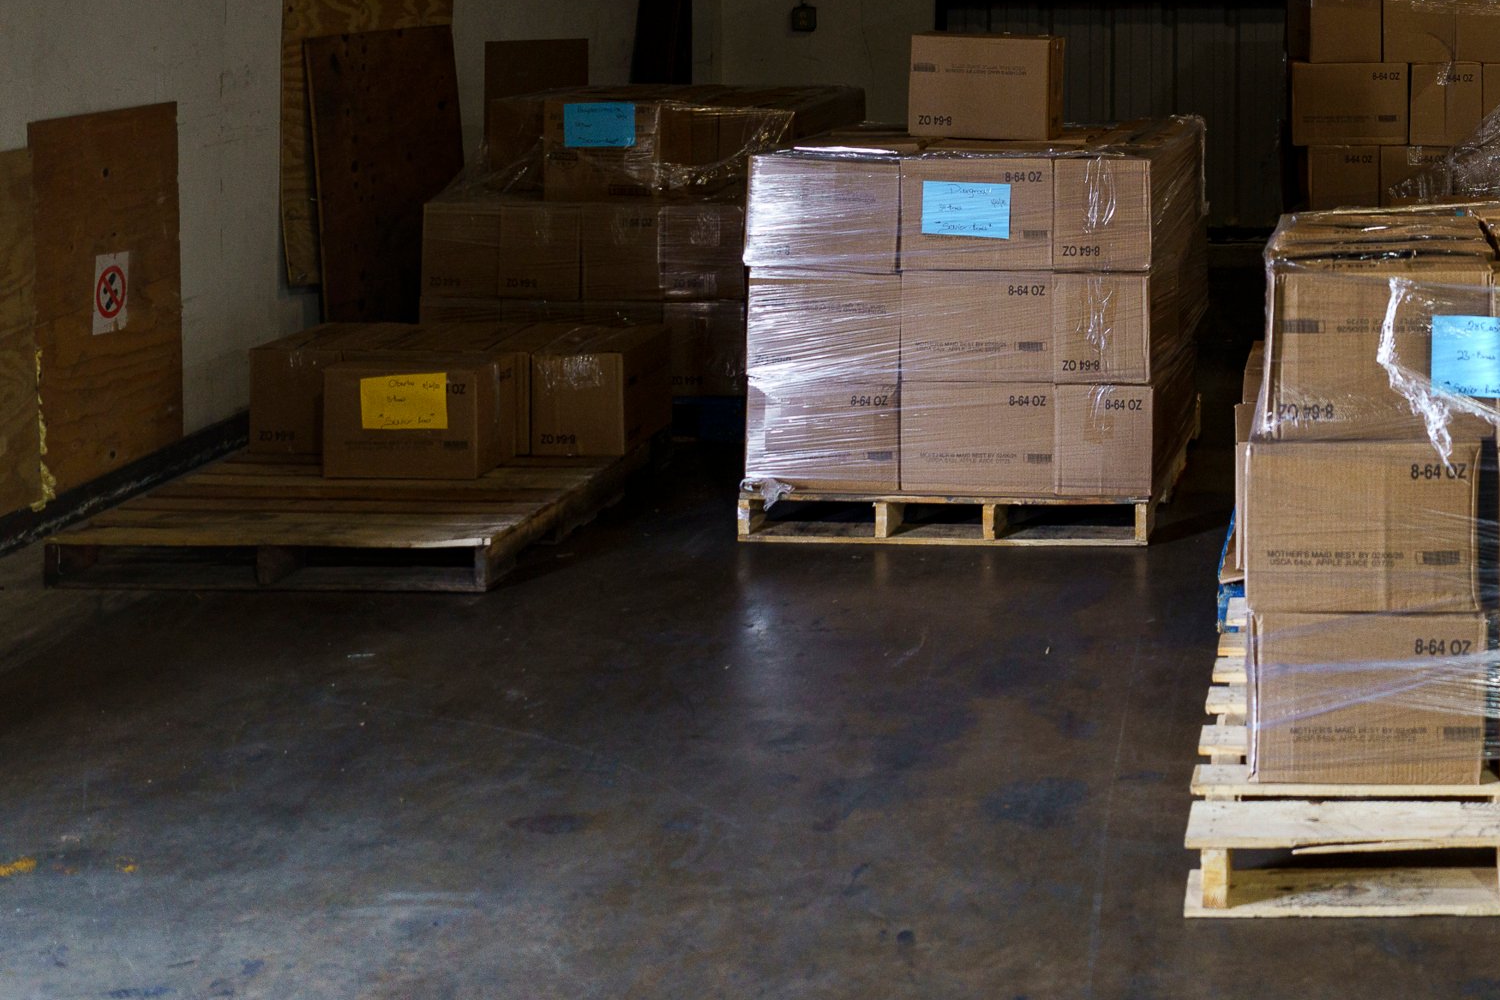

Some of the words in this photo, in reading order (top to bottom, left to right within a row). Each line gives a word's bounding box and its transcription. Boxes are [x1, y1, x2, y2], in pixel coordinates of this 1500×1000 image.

[1388, 72, 1400, 80] OZ
[1462, 73, 1473, 82] OZ
[918, 115, 931, 125] OZ
[934, 116, 952, 126] 8-64
[1362, 155, 1373, 164] OZ
[1005, 171, 1025, 182] 8-64
[1027, 171, 1043, 182] OZ
[1062, 246, 1076, 256] OZ
[1079, 246, 1100, 256] 8-64
[506, 278, 519, 288] OZ
[1008, 285, 1028, 296] 8-64
[1031, 285, 1045, 296] OZ
[1062, 360, 1076, 371] OZ
[1079, 360, 1100, 371] 8-64
[452, 383, 466, 394] OZ
[850, 396, 871, 407] 8-64
[873, 396, 888, 406] OZ
[1009, 396, 1029, 406] 8-64
[1031, 396, 1047, 406] OZ
[1105, 399, 1125, 410] 8-64
[1128, 399, 1142, 410] OZ
[1303, 403, 1334, 420] 8-64
[260, 431, 273, 441] OZ
[540, 434, 554, 445] OZ
[556, 434, 576, 445] 8-64
[1410, 463, 1441, 480] 8-64
[1445, 463, 1467, 479] OZ
[1267, 550, 1309, 558] MOTHER'S
[1334, 551, 1356, 559] BEST
[1358, 551, 1368, 559] BY
[1270, 558, 1293, 566] USDA
[1344, 559, 1367, 567] JUICE
[1414, 638, 1445, 656] 8-64
[1449, 639, 1472, 656] OZ
[1334, 727, 1355, 735] MAID
[1382, 727, 1392, 735] BY
